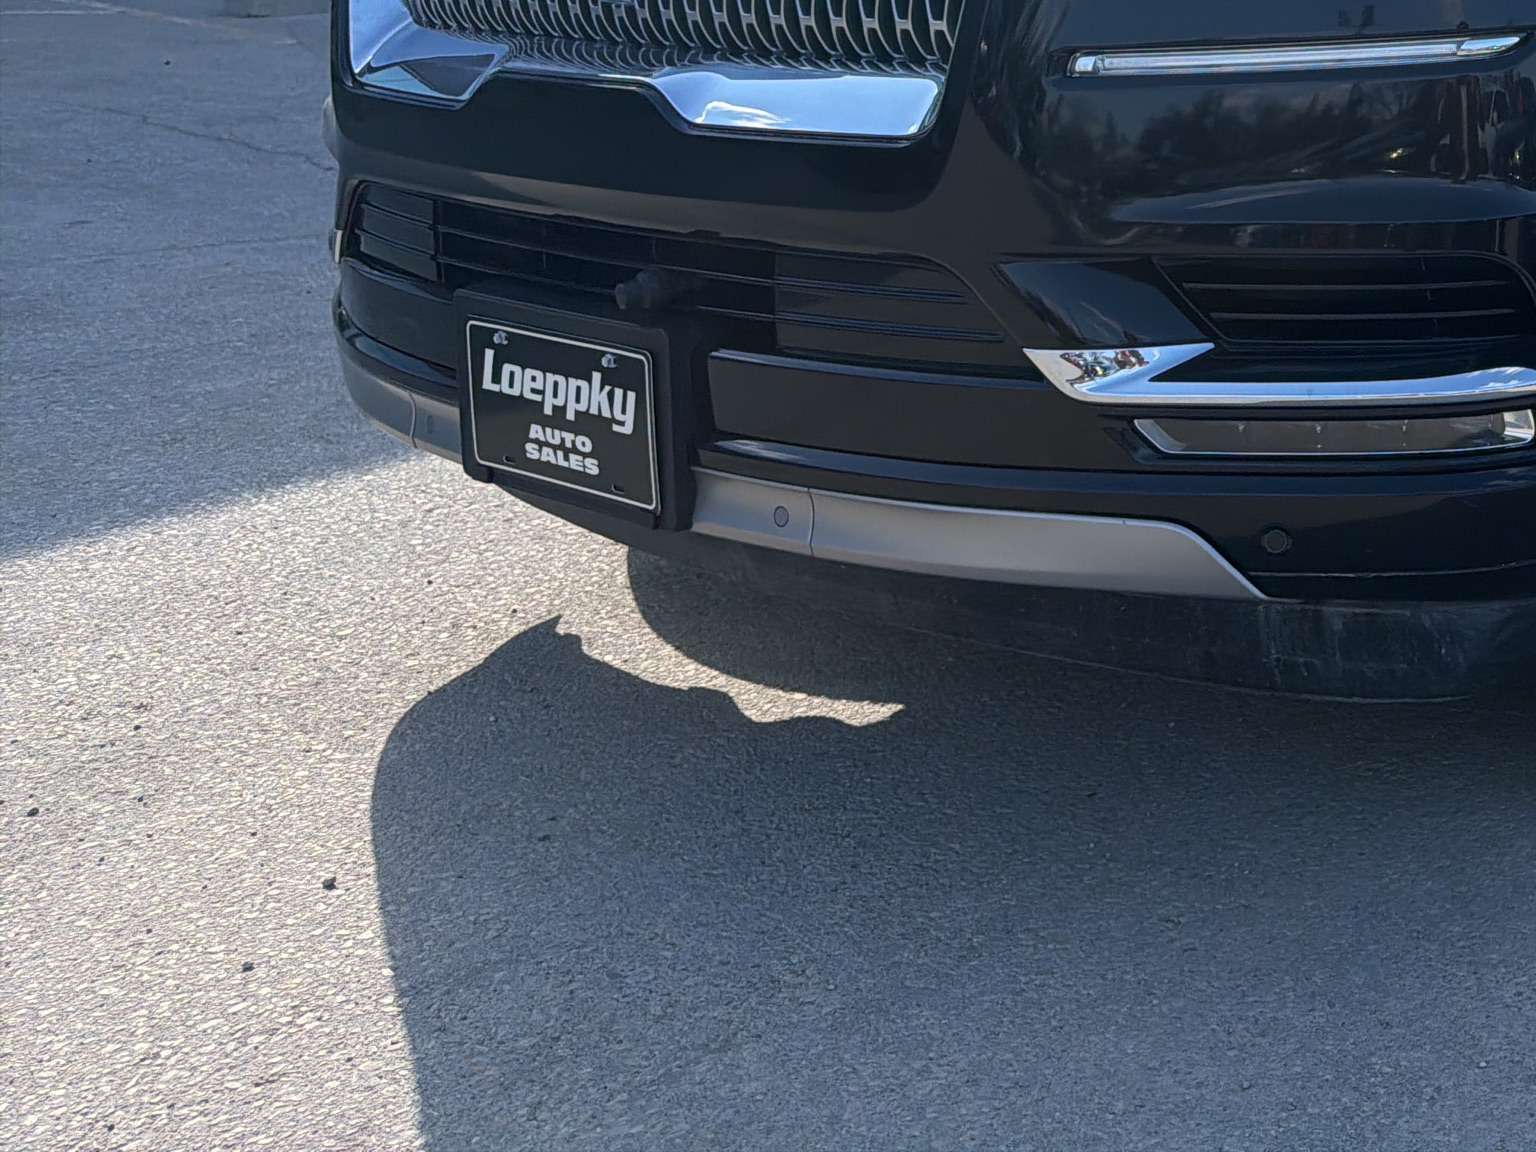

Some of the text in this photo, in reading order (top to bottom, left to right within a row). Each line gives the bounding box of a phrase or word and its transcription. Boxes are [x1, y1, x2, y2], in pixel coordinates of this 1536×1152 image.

[481, 348, 636, 435] Loeppky
[529, 423, 593, 453] AUTO
[524, 442, 600, 476] SALES
